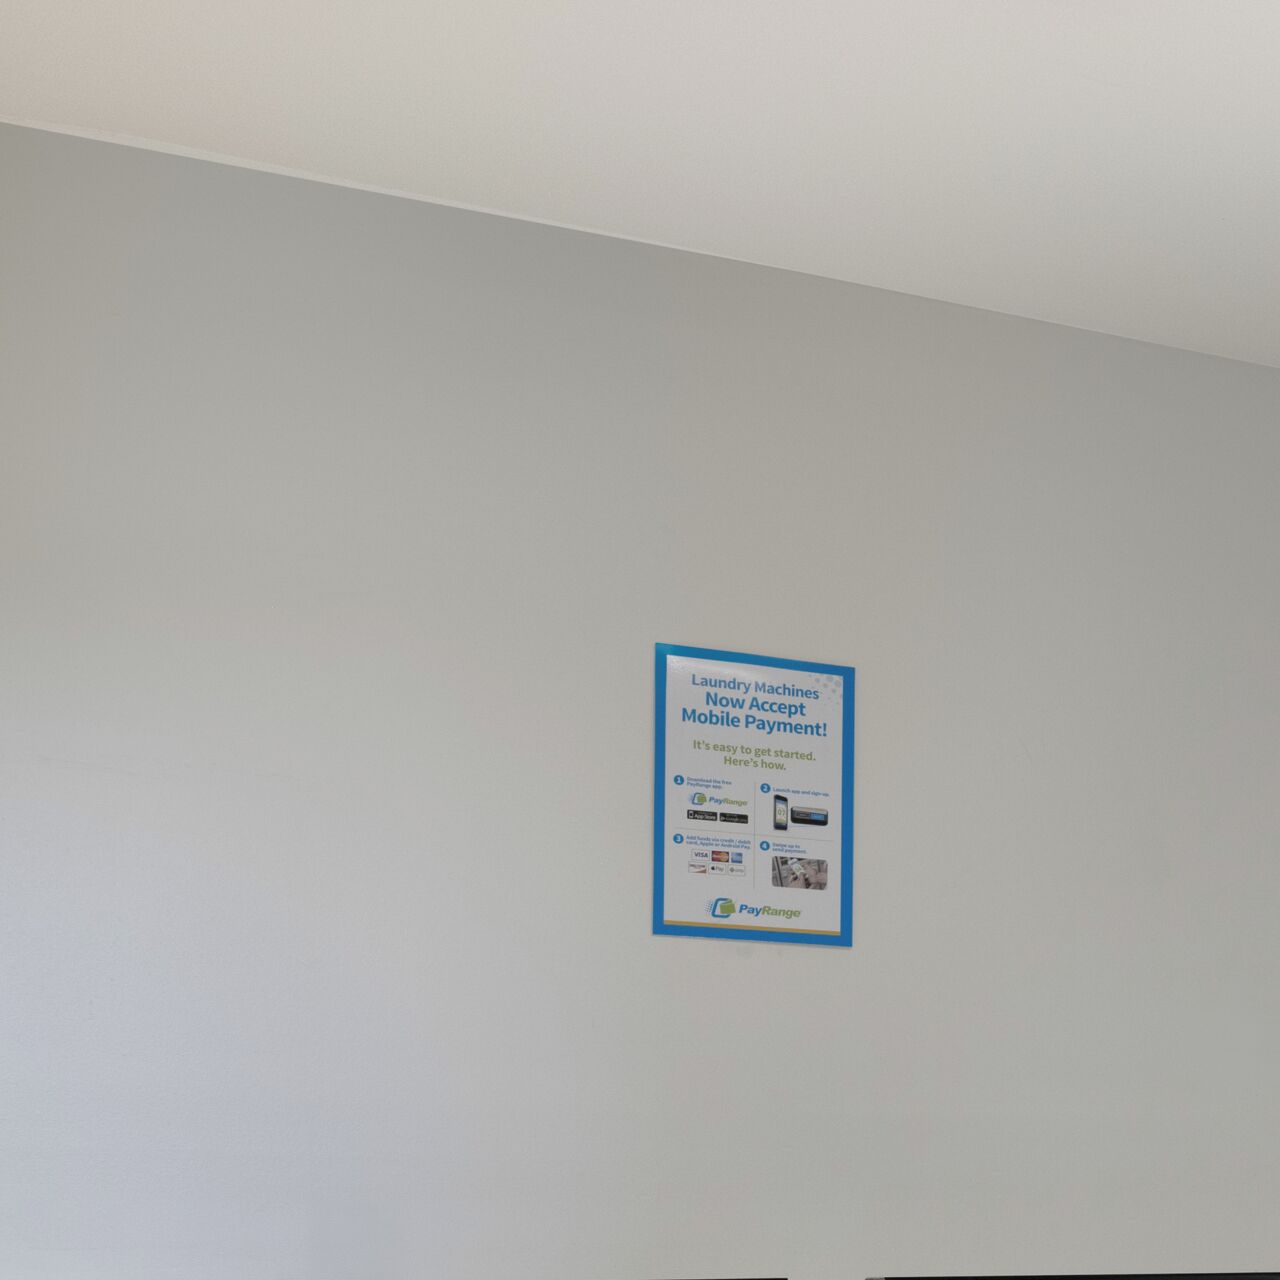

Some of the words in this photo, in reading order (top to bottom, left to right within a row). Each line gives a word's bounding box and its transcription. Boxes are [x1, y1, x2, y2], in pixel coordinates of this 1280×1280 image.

[692, 674, 751, 694] Laundry
[755, 681, 819, 700] Machines
[706, 692, 745, 709] Now
[749, 697, 806, 718] Accept
[682, 708, 740, 727] Mobile
[745, 715, 827, 737] Payment!
[693, 740, 711, 750] It's
[713, 743, 738, 755] easy
[741, 744, 752, 754] to
[754, 746, 771, 757] get
[773, 749, 816, 761] started.
[724, 756, 758, 767] Here's
[761, 759, 786, 770] how.
[709, 796, 748, 806] PayRange
[739, 904, 801, 919] PayRange
